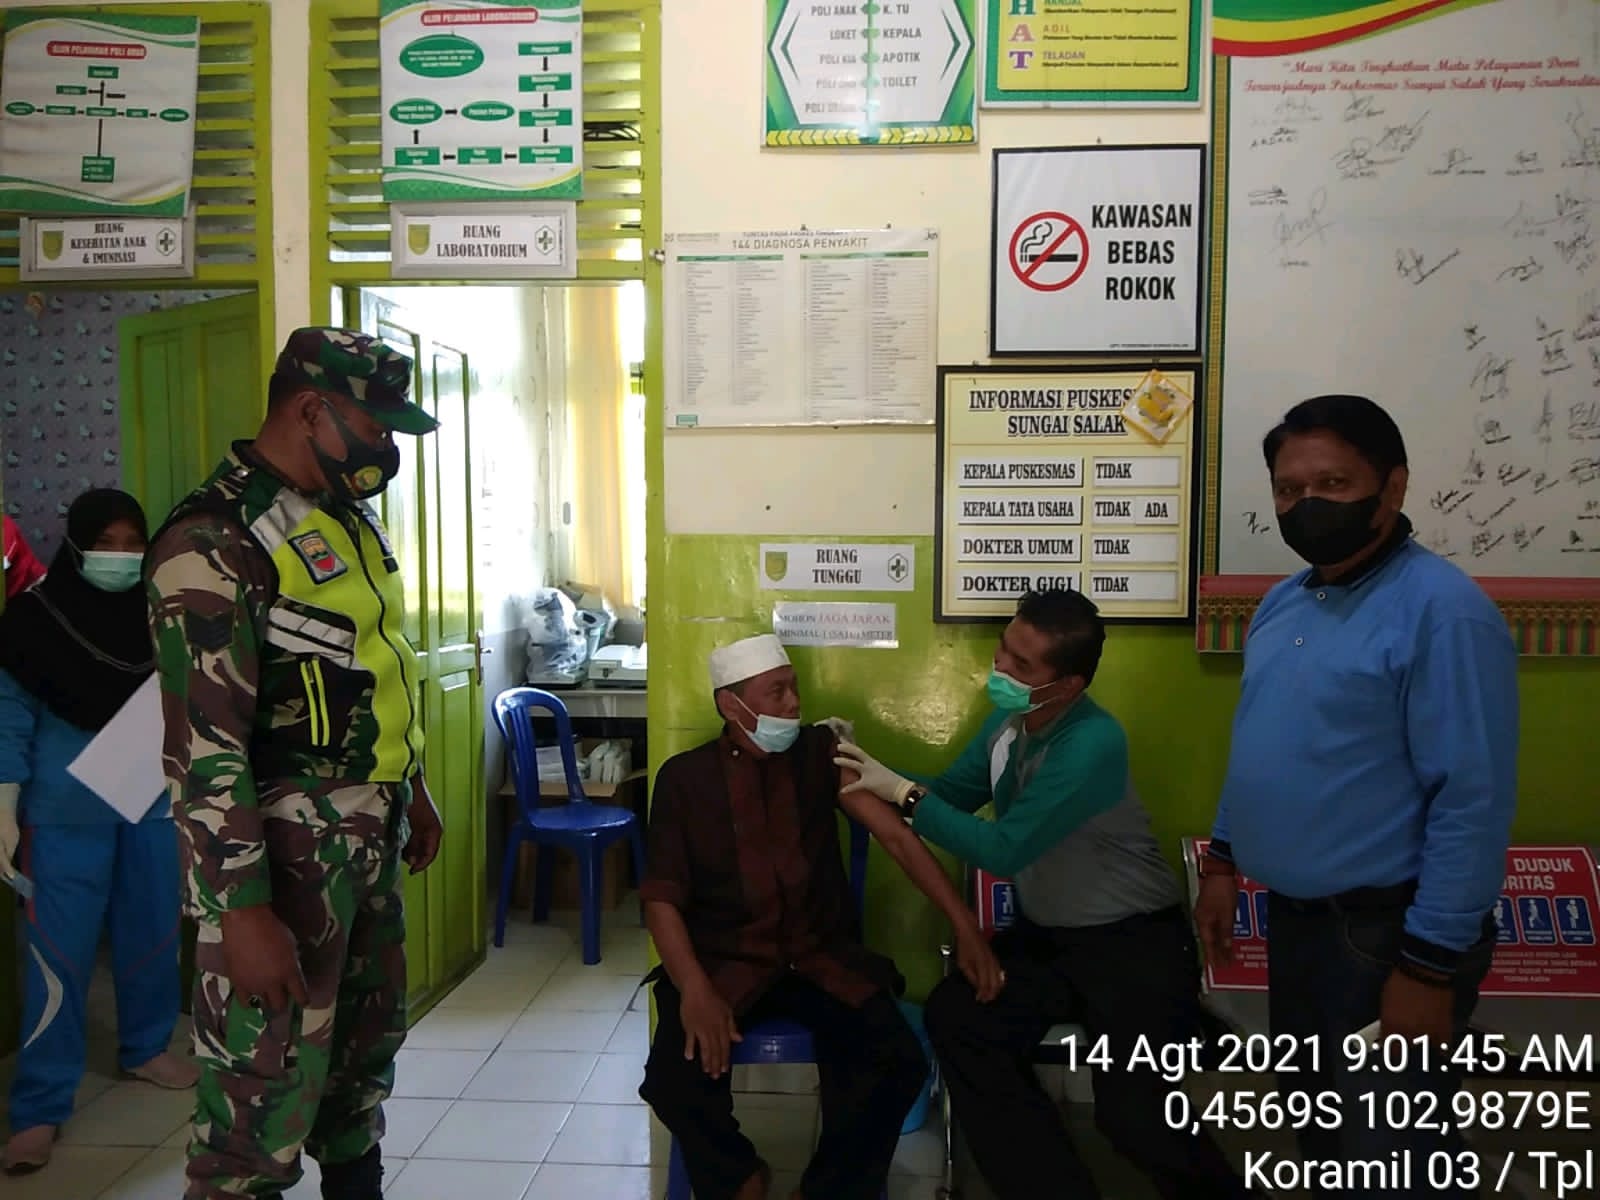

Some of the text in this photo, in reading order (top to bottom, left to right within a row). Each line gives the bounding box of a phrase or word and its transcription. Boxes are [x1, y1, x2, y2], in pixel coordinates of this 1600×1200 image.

[811, 5, 831, 16] POLI
[896, 5, 910, 14] TU
[830, 29, 857, 40] LOKET
[883, 28, 922, 39] KEPALA
[1008, 24, 1035, 42] A
[883, 52, 921, 63] APOTIK
[1008, 51, 1033, 69] T
[1043, 51, 1086, 60] TELADAN
[883, 77, 917, 87] TOILET
[1092, 203, 1192, 229] KAWASAN
[95, 222, 124, 234] RUANG
[463, 225, 501, 239] RUANG
[70, 236, 147, 250] KESEHATAN ANAK
[732, 237, 869, 250] 144 DIAGNOSA PENYAKIT
[82, 251, 136, 264] & IMUNISASI
[437, 244, 528, 258] LABORATORIUM
[1107, 240, 1175, 265] BEBAS
[1105, 276, 1176, 301] ROKOK
[969, 388, 1137, 410] INFORMASI PUSKES
[1008, 414, 1127, 435] SUNGAI SALAK
[963, 463, 1132, 480] KEPALA PUSKESMAS TIDAK
[963, 501, 1168, 518] KEPALA TATA USAHA TIDAK ADA
[963, 539, 1130, 555] DOKTER UMUM TIDAK
[816, 549, 858, 564] RUANG
[812, 569, 862, 584] TUNGGU
[962, 576, 1129, 592] DOKTER GIGI TIDAK
[817, 612, 849, 625] JAGA
[852, 613, 891, 625] JARAK
[779, 628, 821, 639] MINIMAL
[1513, 858, 1575, 873] DUDUK
